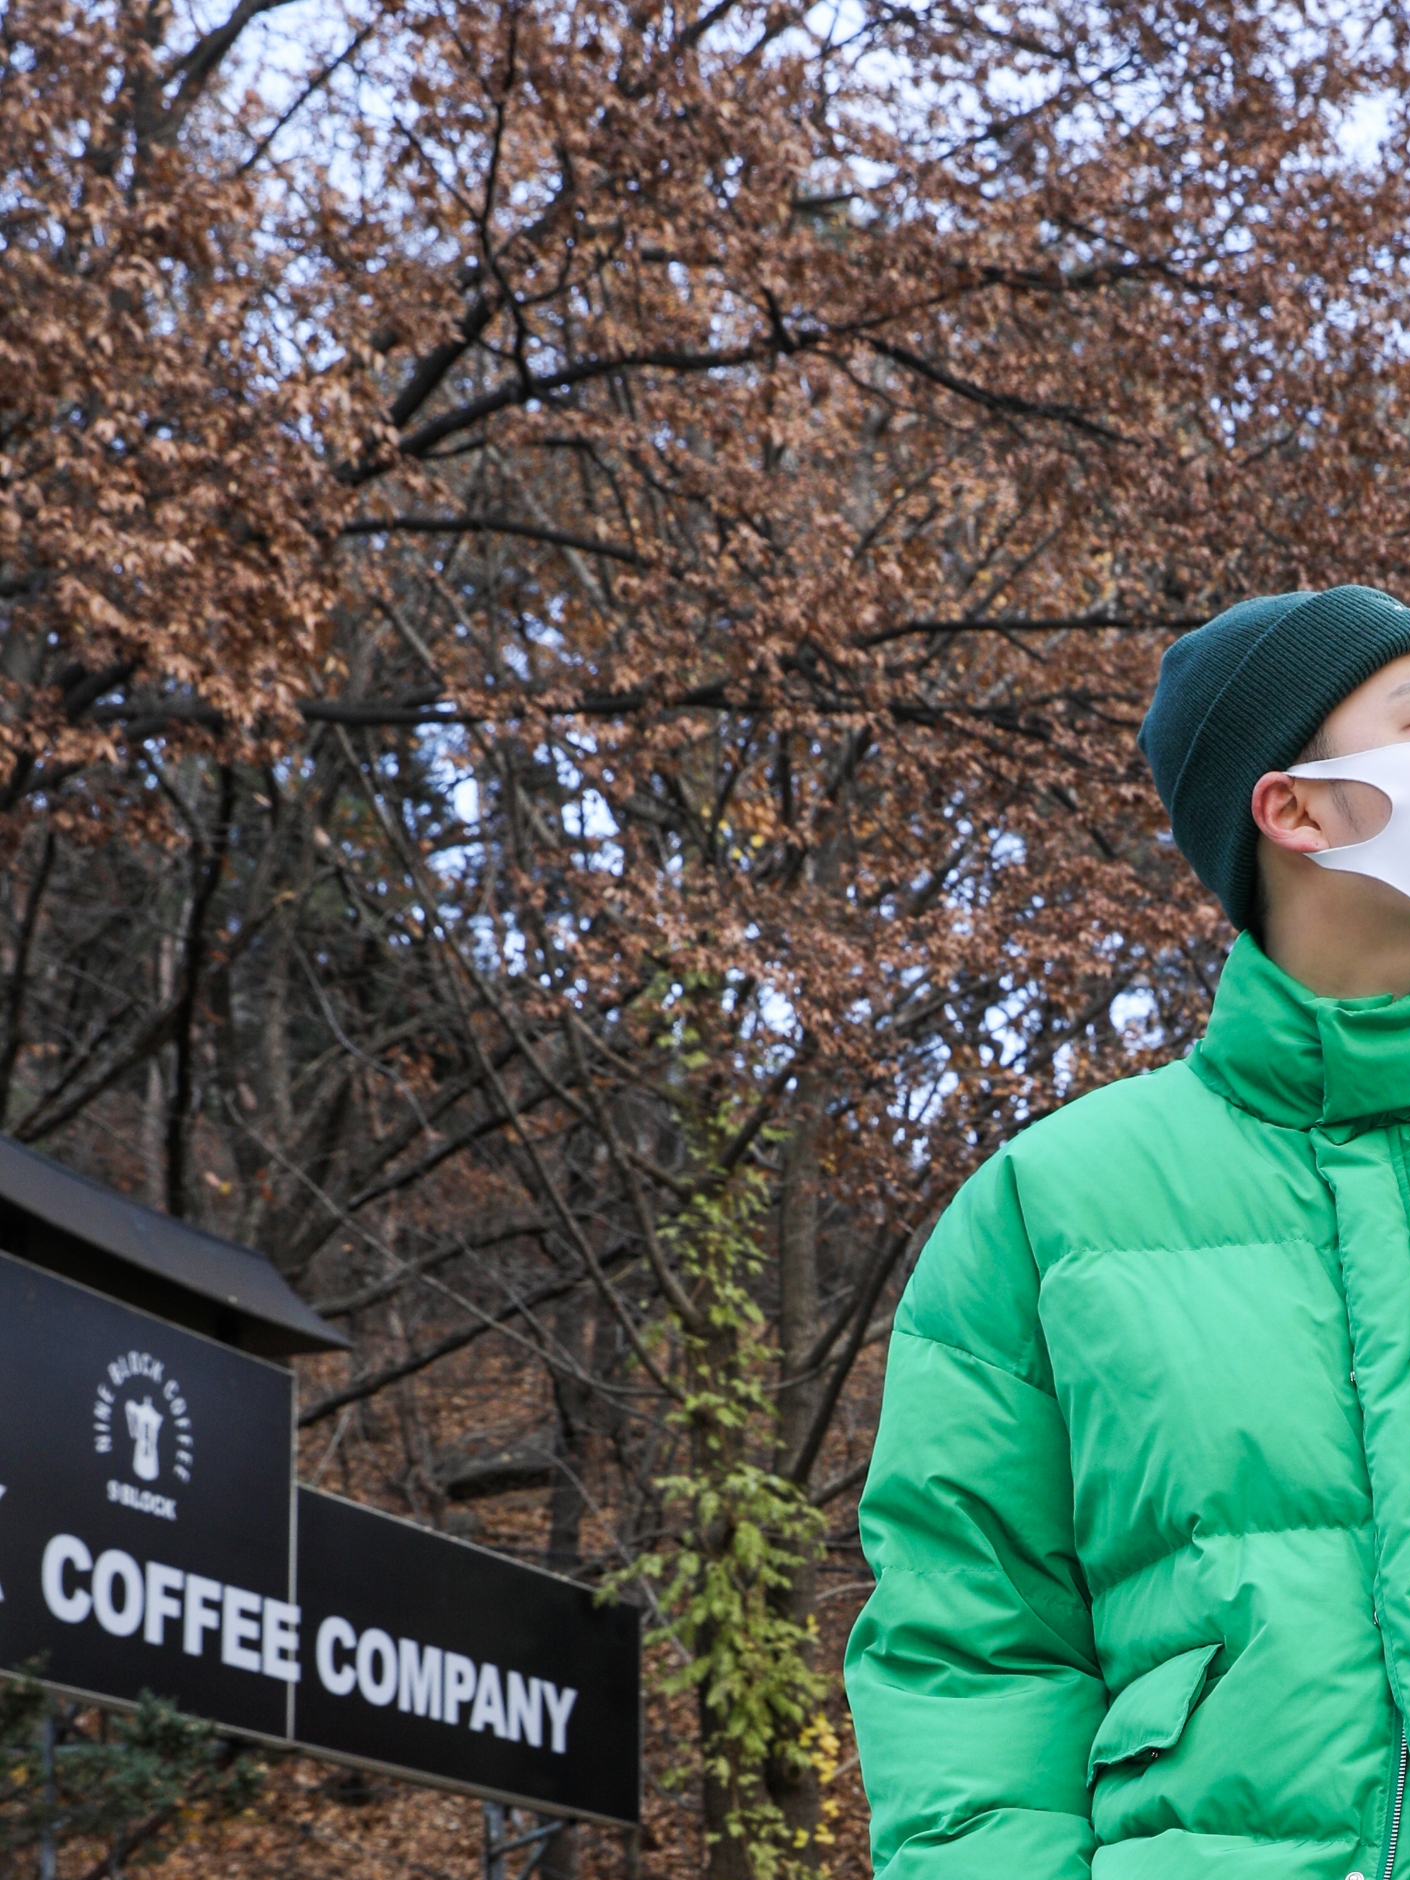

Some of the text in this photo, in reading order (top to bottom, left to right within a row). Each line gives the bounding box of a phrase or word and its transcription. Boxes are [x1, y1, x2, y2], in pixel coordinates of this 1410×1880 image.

[93, 1350, 194, 1484] NINE BLOCK COFFEE
[42, 1533, 301, 1682] COFFEE
[316, 1616, 577, 1754] COMPANY
